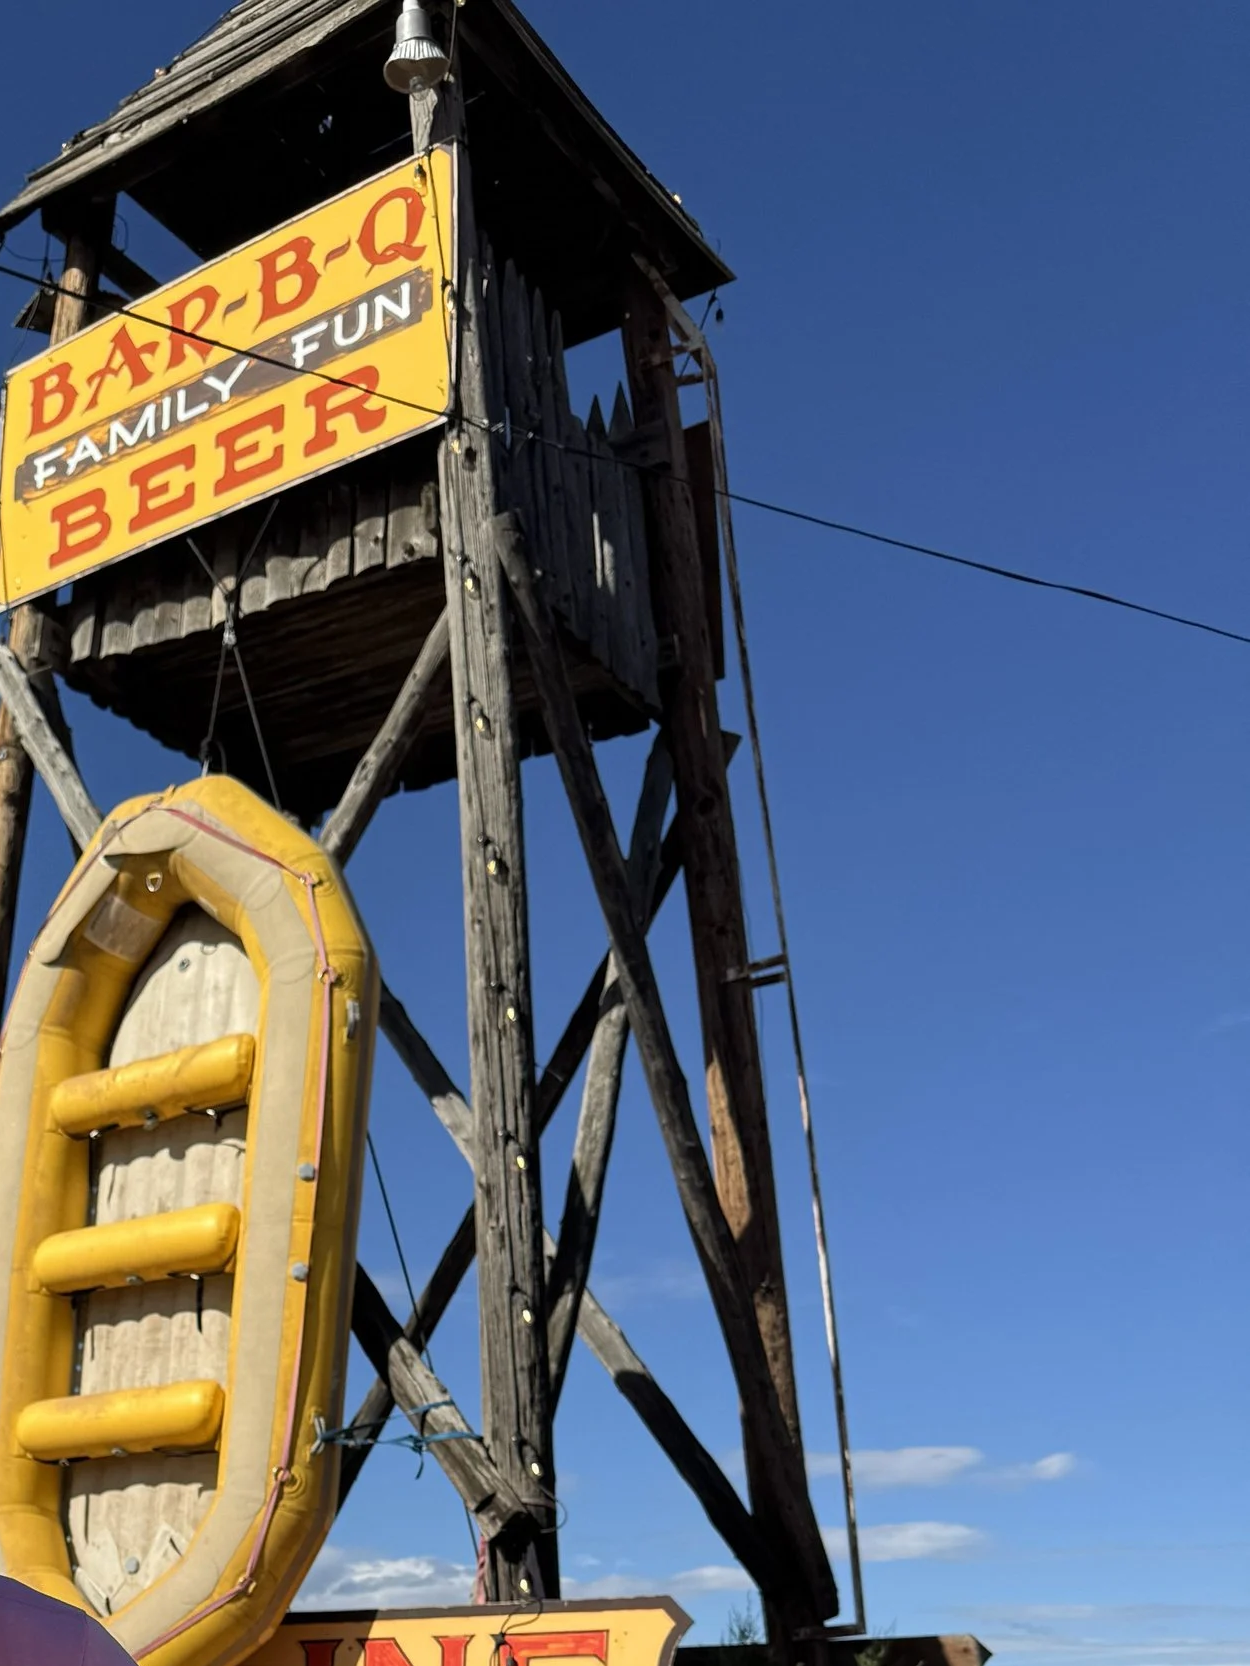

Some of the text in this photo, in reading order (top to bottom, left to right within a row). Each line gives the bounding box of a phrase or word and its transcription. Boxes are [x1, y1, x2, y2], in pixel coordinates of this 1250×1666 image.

[25, 187, 428, 441] BAR-B-Q
[32, 282, 412, 490] FAMILY FUN
[49, 365, 388, 570] BEER
